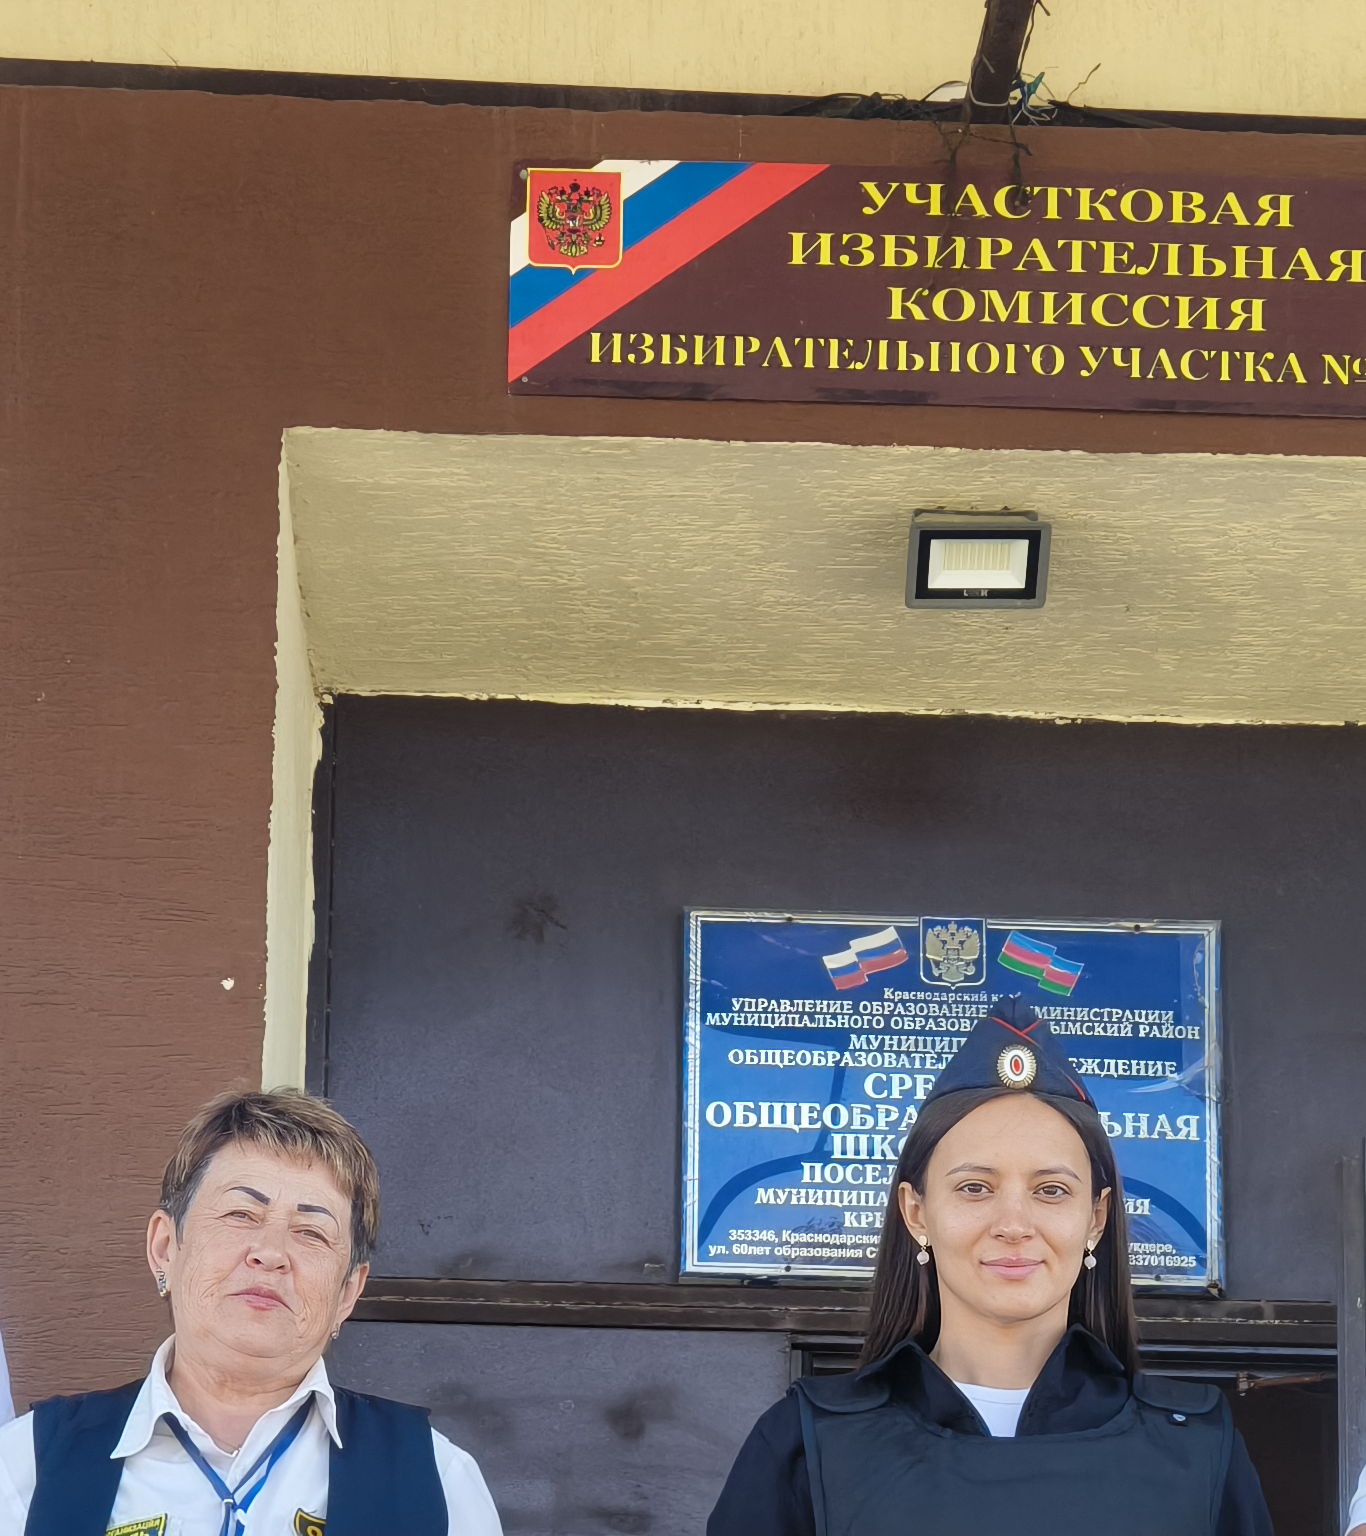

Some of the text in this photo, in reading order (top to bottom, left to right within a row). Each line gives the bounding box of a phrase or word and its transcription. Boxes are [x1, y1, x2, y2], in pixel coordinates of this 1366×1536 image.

[858, 180, 1295, 228] УЧАСТКОВАЯ
[787, 231, 1366, 283] ИЗБИРАТЕЛЬНАЯ
[886, 286, 1267, 332] КОМИССИЯ
[589, 332, 1066, 376] ИЗБИРАТЕЛЬНОГО
[1078, 346, 1308, 385] УЧАСТКА
[883, 987, 988, 1004] Краснодарский
[731, 997, 993, 1018] УПРАВЛЕНИЕ ОБРАЗОВАНИЕ
[1032, 1005, 1175, 1024] МИНИСТРАЦИИ
[704, 1012, 978, 1033] МУНИЦИПАЛЬНОГО ОБРАЗОВ
[1049, 1021, 1201, 1041] ЫМСКИЙ РАЙОН
[848, 1033, 967, 1054] МУНИЦИП
[727, 1048, 955, 1069] ОБЩЕОБРАЗОВАТЕЛ
[1068, 1057, 1178, 1079] ЕЖДЕНИЕ
[863, 1072, 936, 1100] СРЕ
[705, 1100, 918, 1134] ОБЩЕОБРА
[754, 1187, 889, 1208] МУНИЦИПА
[728, 1229, 882, 1246] 353346, Краснодарски
[708, 1245, 729, 1257] ул.
[732, 1243, 772, 1256] 60лет
[774, 1244, 863, 1260] образования
[1129, 1254, 1197, 1268] 337016925
